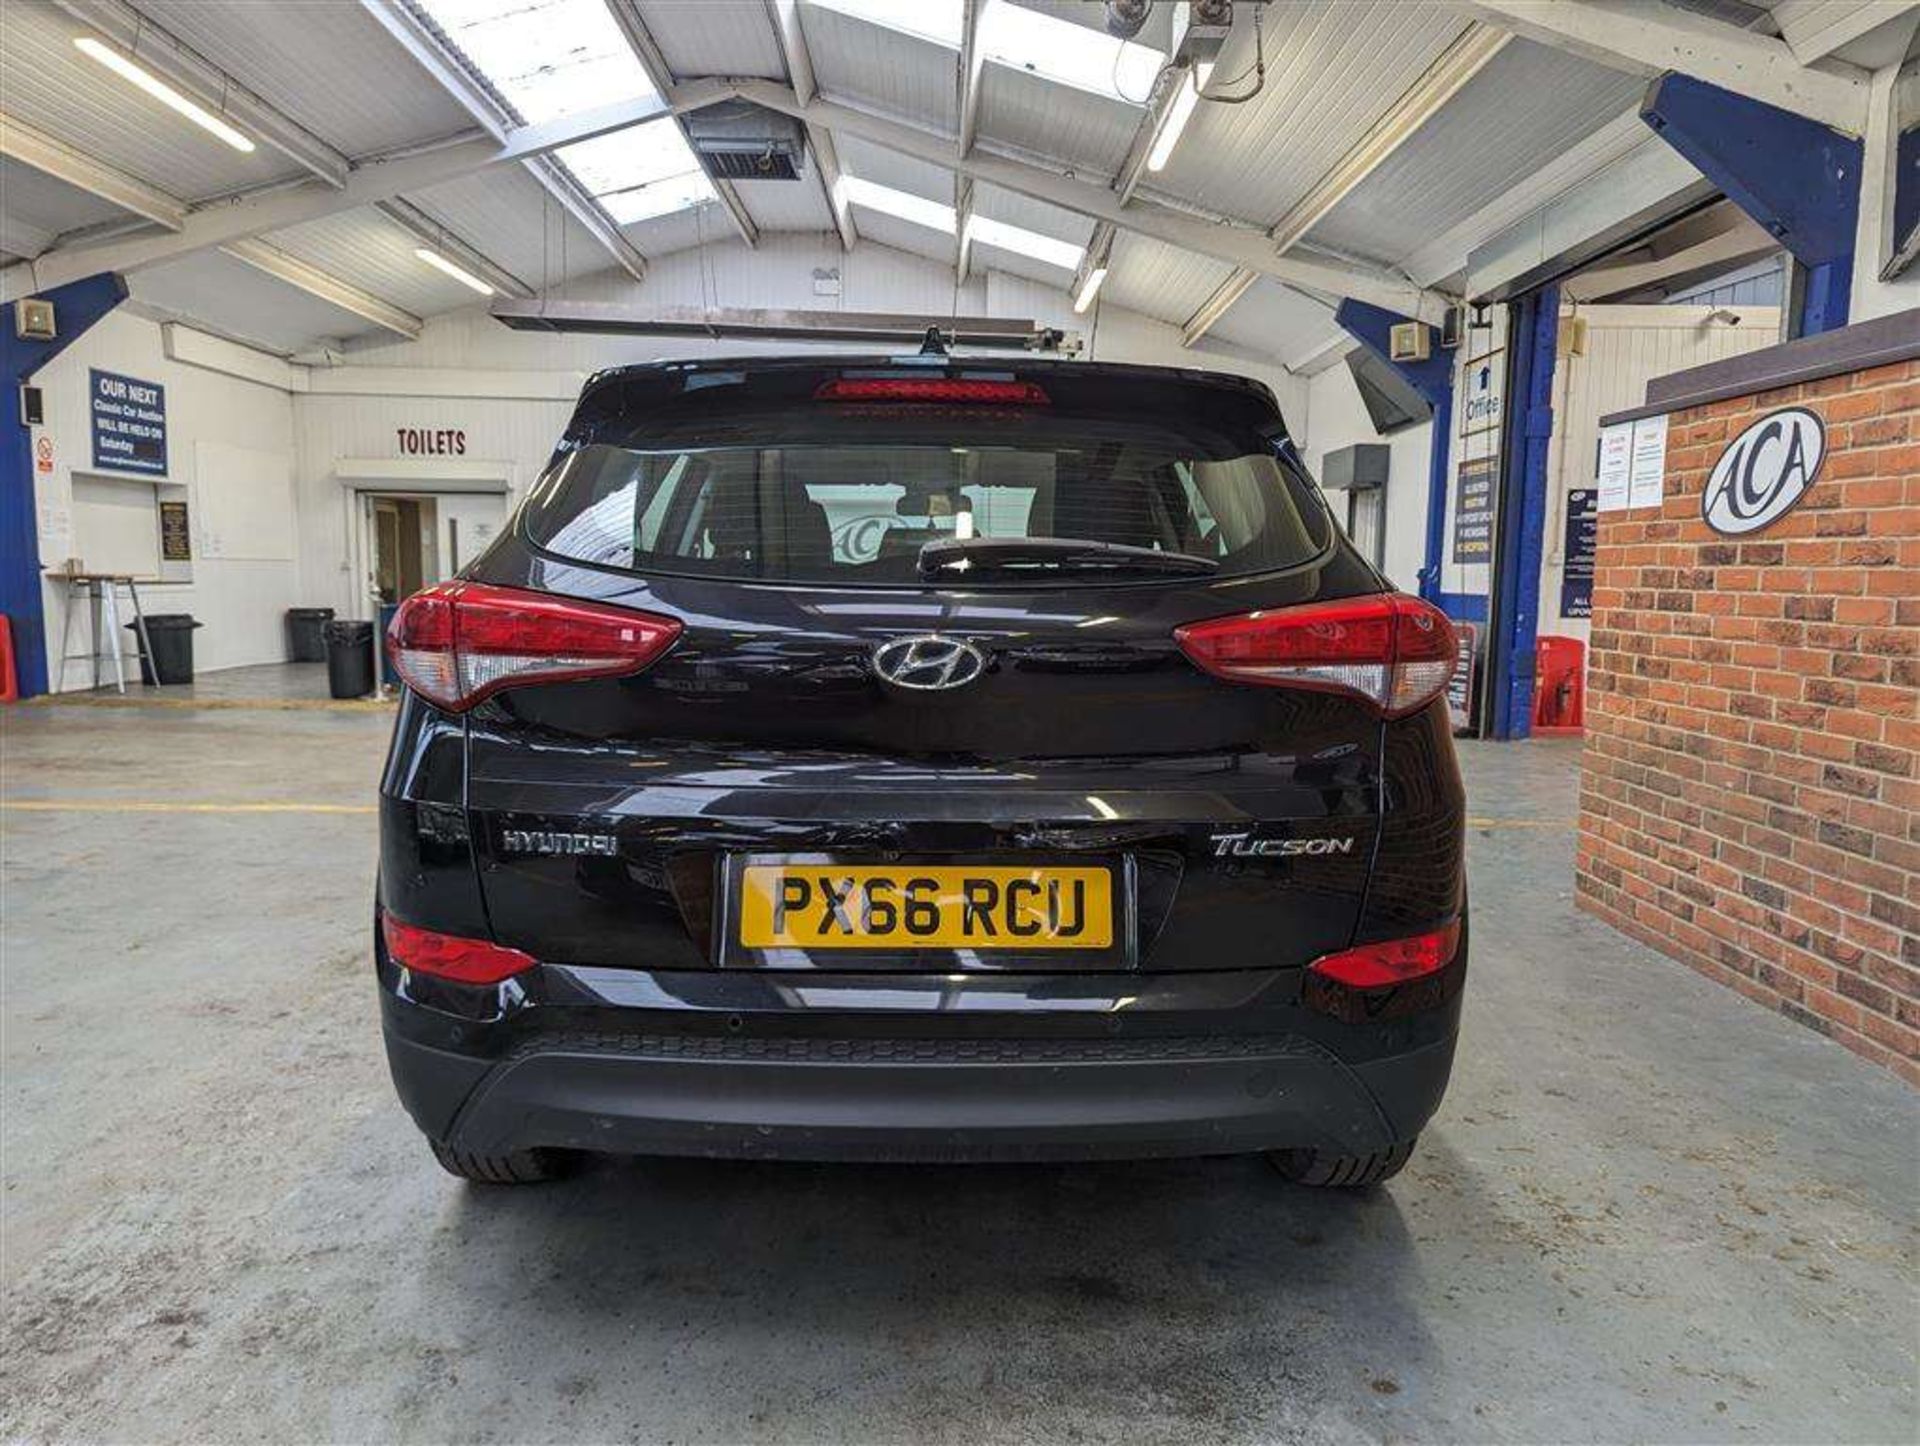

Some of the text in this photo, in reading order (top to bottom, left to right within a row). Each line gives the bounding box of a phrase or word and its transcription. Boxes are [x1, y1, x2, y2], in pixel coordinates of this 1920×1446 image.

[100, 378, 158, 406] OUR NEXT
[1466, 396, 1500, 421] Office
[397, 428, 467, 456] TOILETS
[1705, 420, 1807, 521] ACA
[503, 830, 617, 856] HYUNDAI
[1210, 832, 1355, 857] TUCSON
[773, 877, 1086, 938] PX66 RCU
